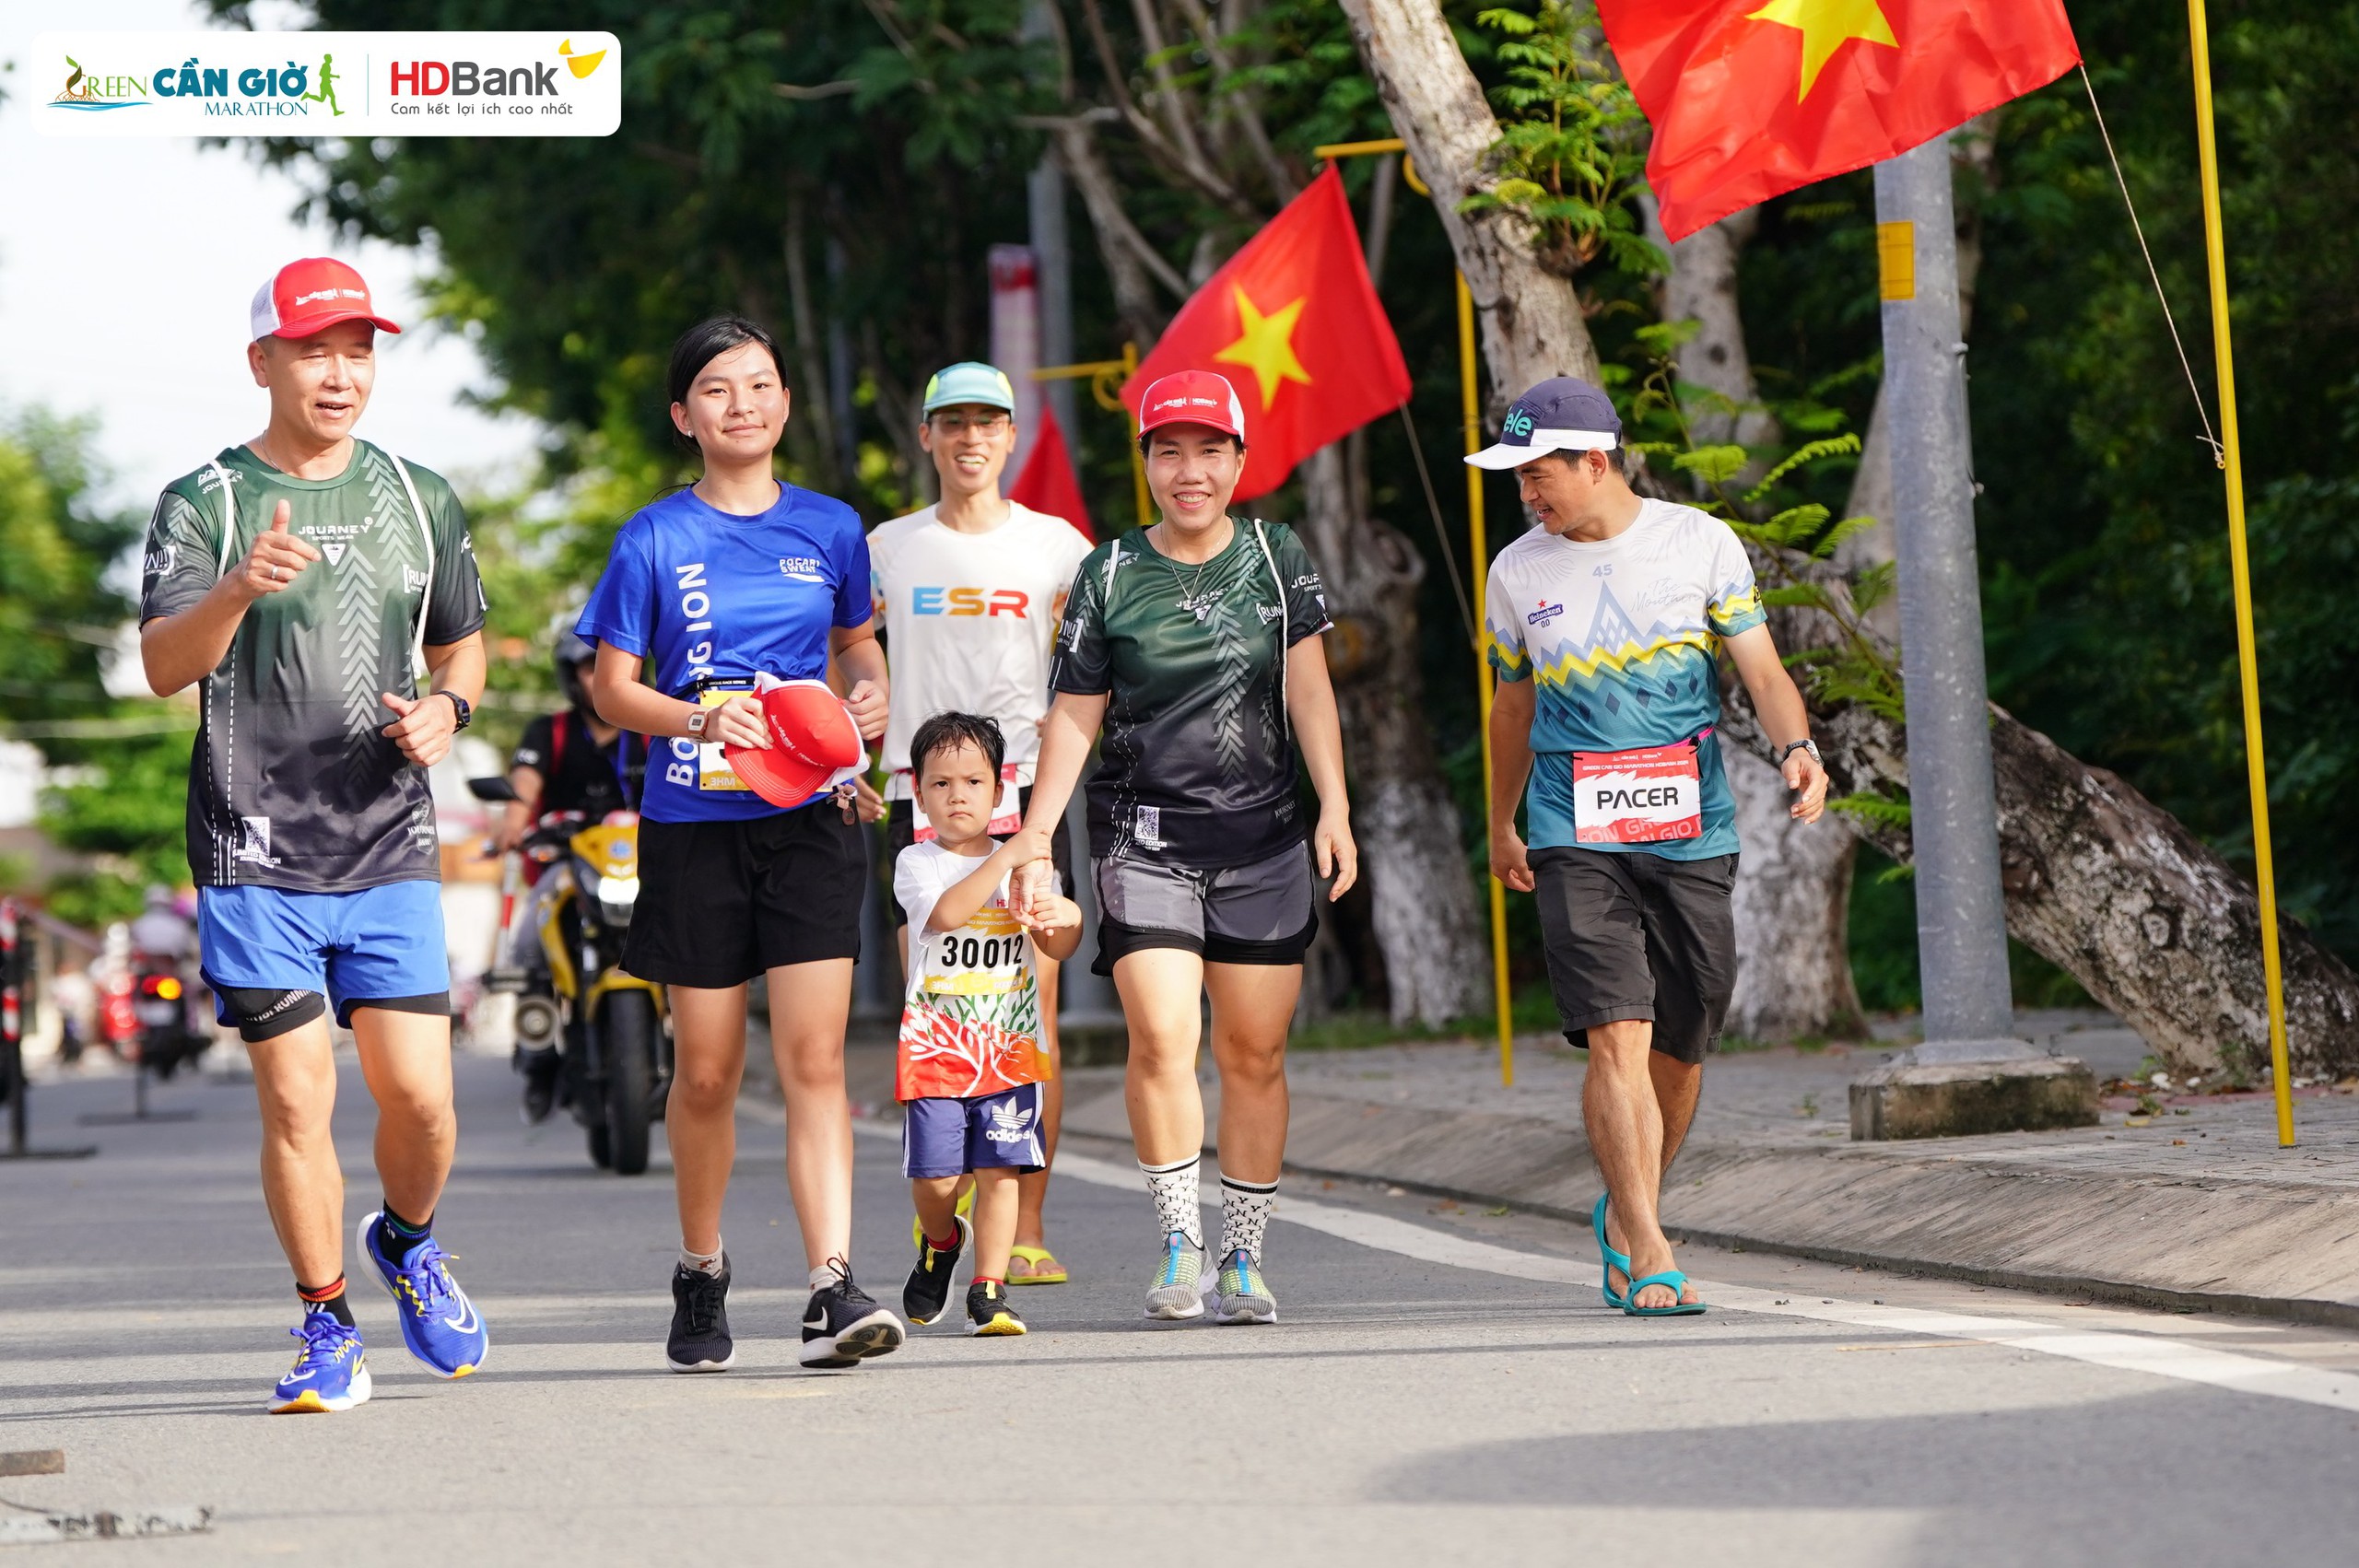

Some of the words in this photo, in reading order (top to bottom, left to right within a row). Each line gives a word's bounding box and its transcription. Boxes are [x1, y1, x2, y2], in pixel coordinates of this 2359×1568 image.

[299, 523, 371, 535] JOURNEY
[779, 557, 820, 568] POCARI
[1592, 564, 1613, 578] 45
[912, 587, 1029, 618] ESR
[1529, 607, 1562, 624] Heineken
[1597, 787, 1678, 810] PACER
[941, 934, 1024, 968] 30012
